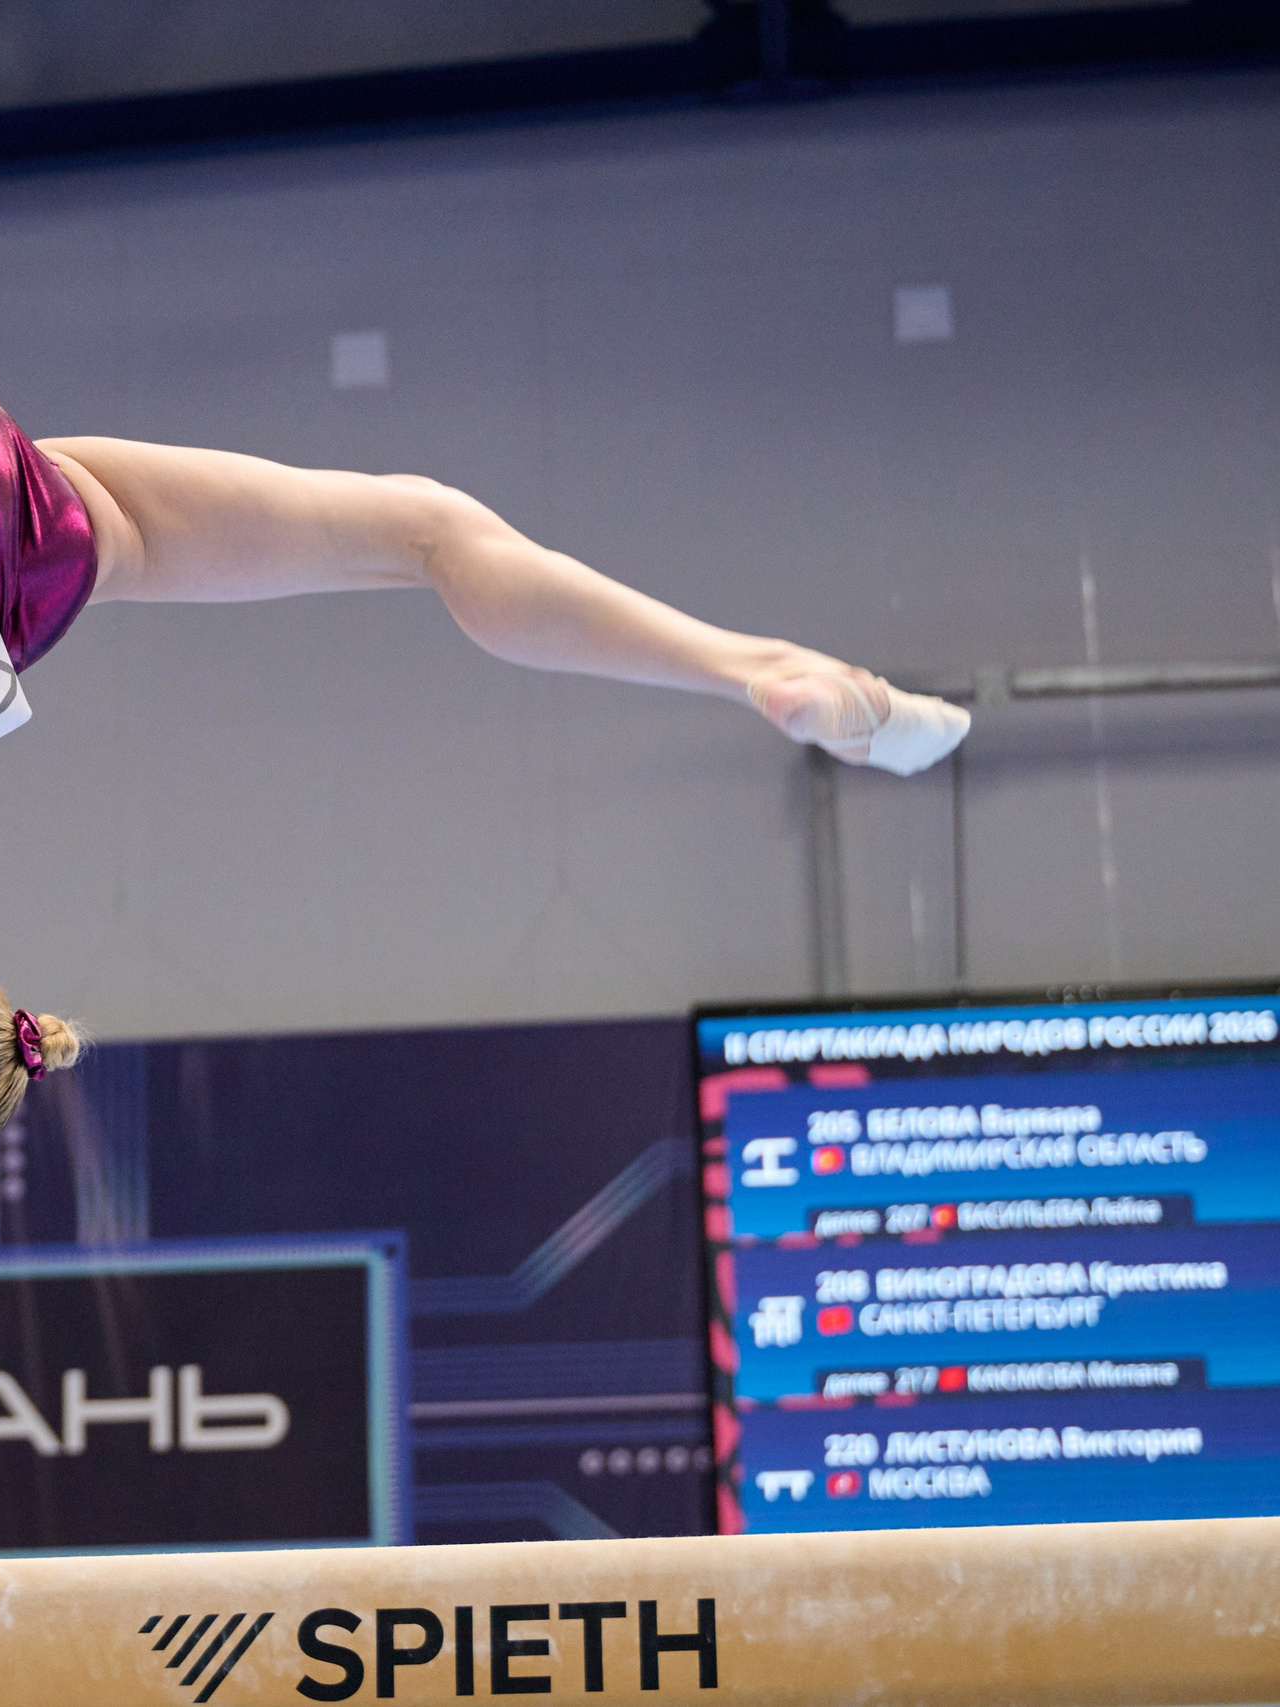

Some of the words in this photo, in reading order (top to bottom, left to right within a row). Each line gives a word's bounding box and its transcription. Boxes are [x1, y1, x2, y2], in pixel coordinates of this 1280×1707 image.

[747, 1022, 949, 1064] СПАРТАКИАДА
[948, 1016, 1087, 1056] НАРОДОВ
[1088, 1012, 1208, 1049] РОССИИ
[866, 1105, 980, 1141] БЕЛОВА
[850, 1134, 1076, 1177] ВЛАДИМИРСКАЯ
[1077, 1130, 1208, 1168] ОБЛАСТЬ
[875, 1261, 1090, 1301] ВИНОГРАДОВА
[824, 1432, 880, 1466] 220
[883, 1427, 1062, 1466] ЛИСТУНОВА
[868, 1464, 992, 1501] МОСКВА
[294, 1598, 719, 1702] SPIETH
